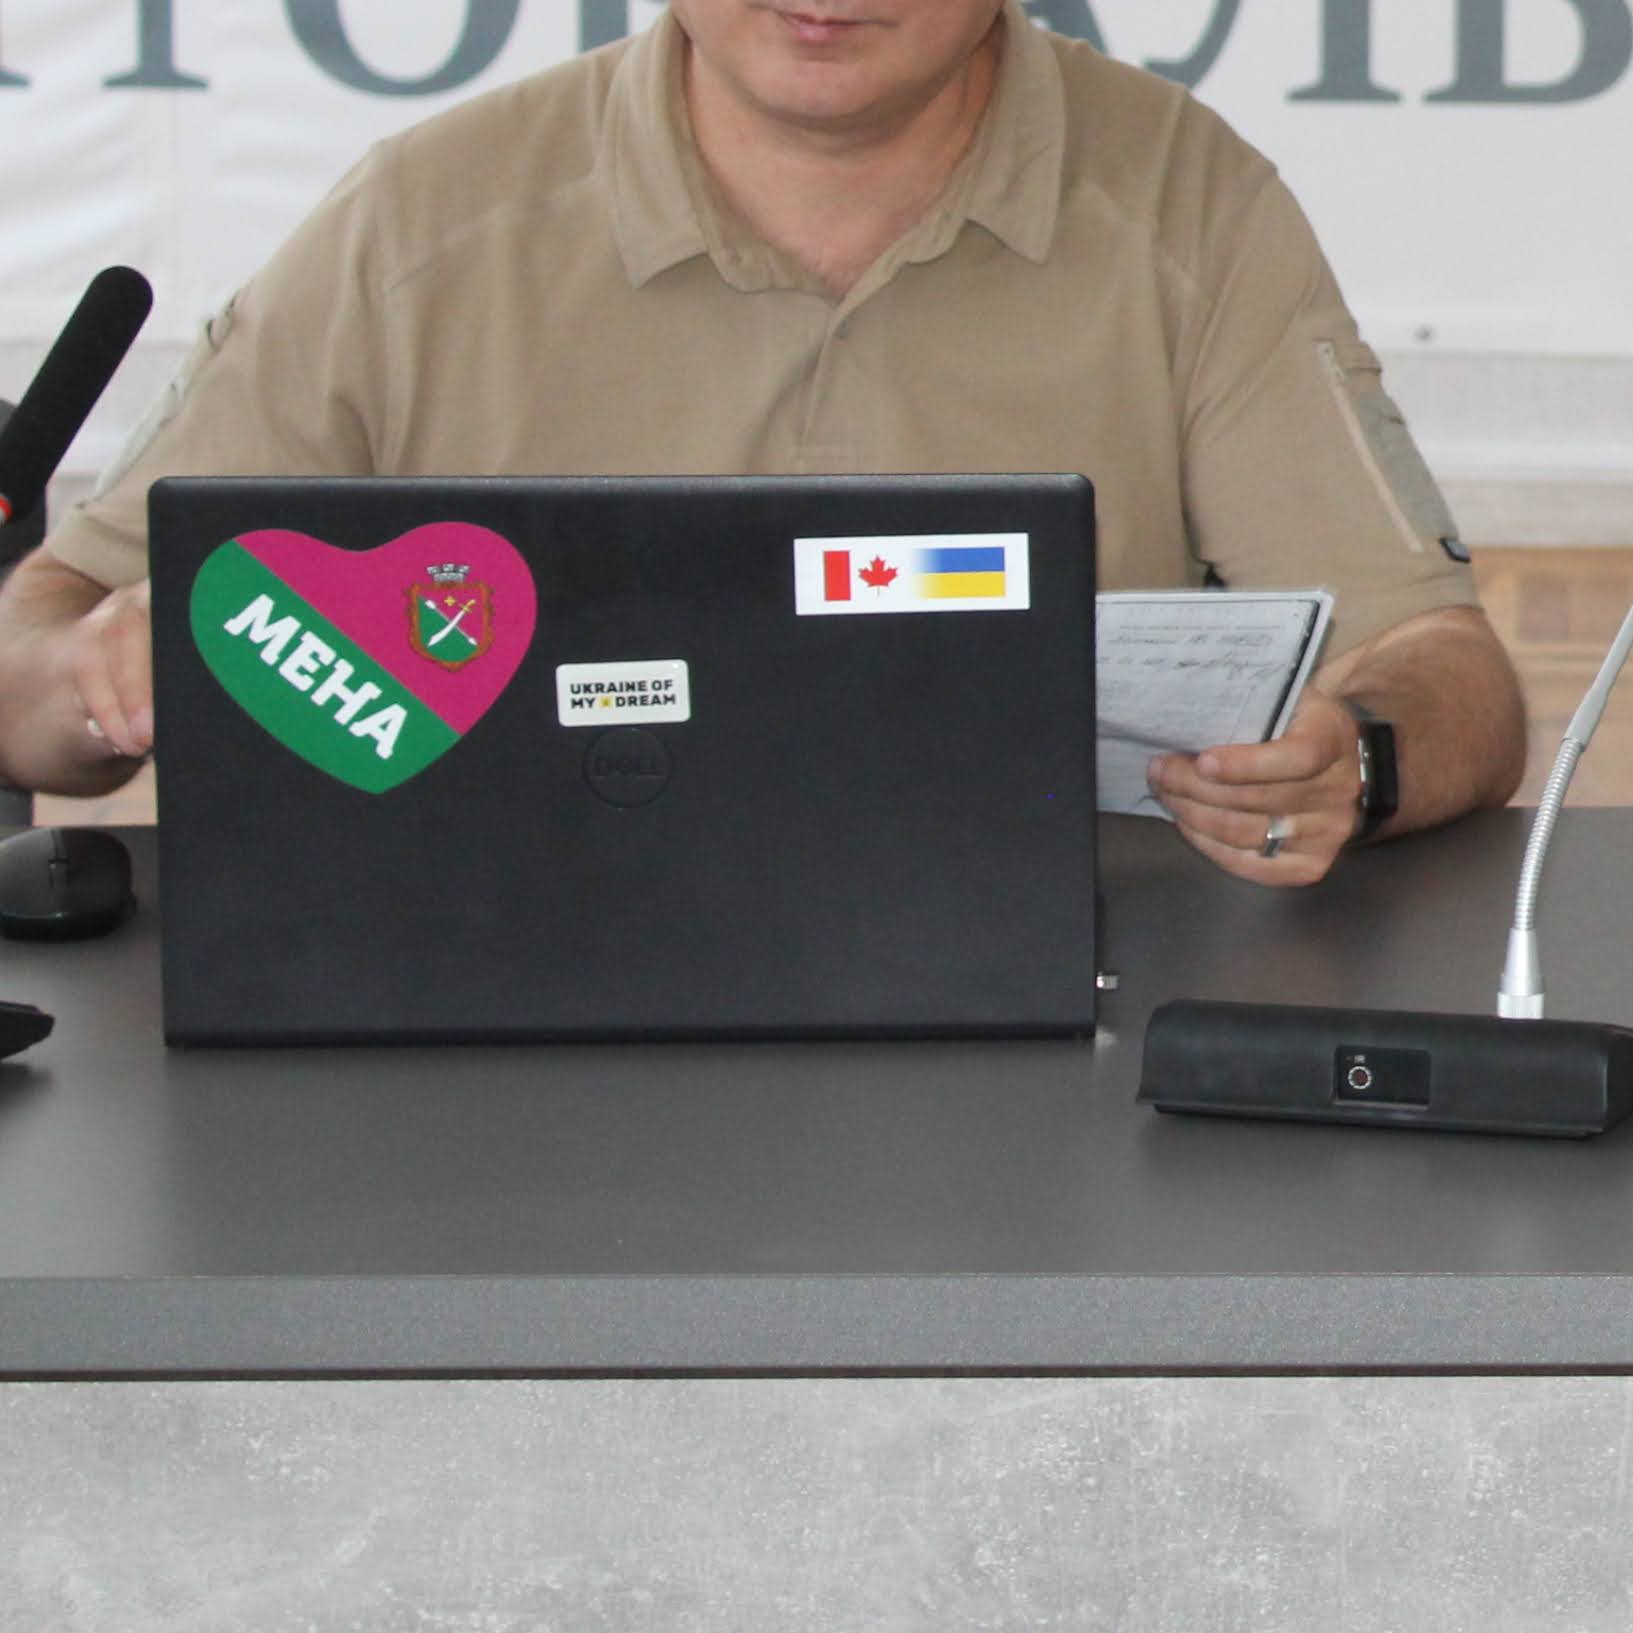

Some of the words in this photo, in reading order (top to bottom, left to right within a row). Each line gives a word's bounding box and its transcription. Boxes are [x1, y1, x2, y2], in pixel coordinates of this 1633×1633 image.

[223, 593, 408, 759] МЕНА
[570, 680, 648, 694] UKRAINE
[651, 679, 673, 692] OF
[571, 697, 595, 709] MY
[615, 694, 676, 707] DREAM
